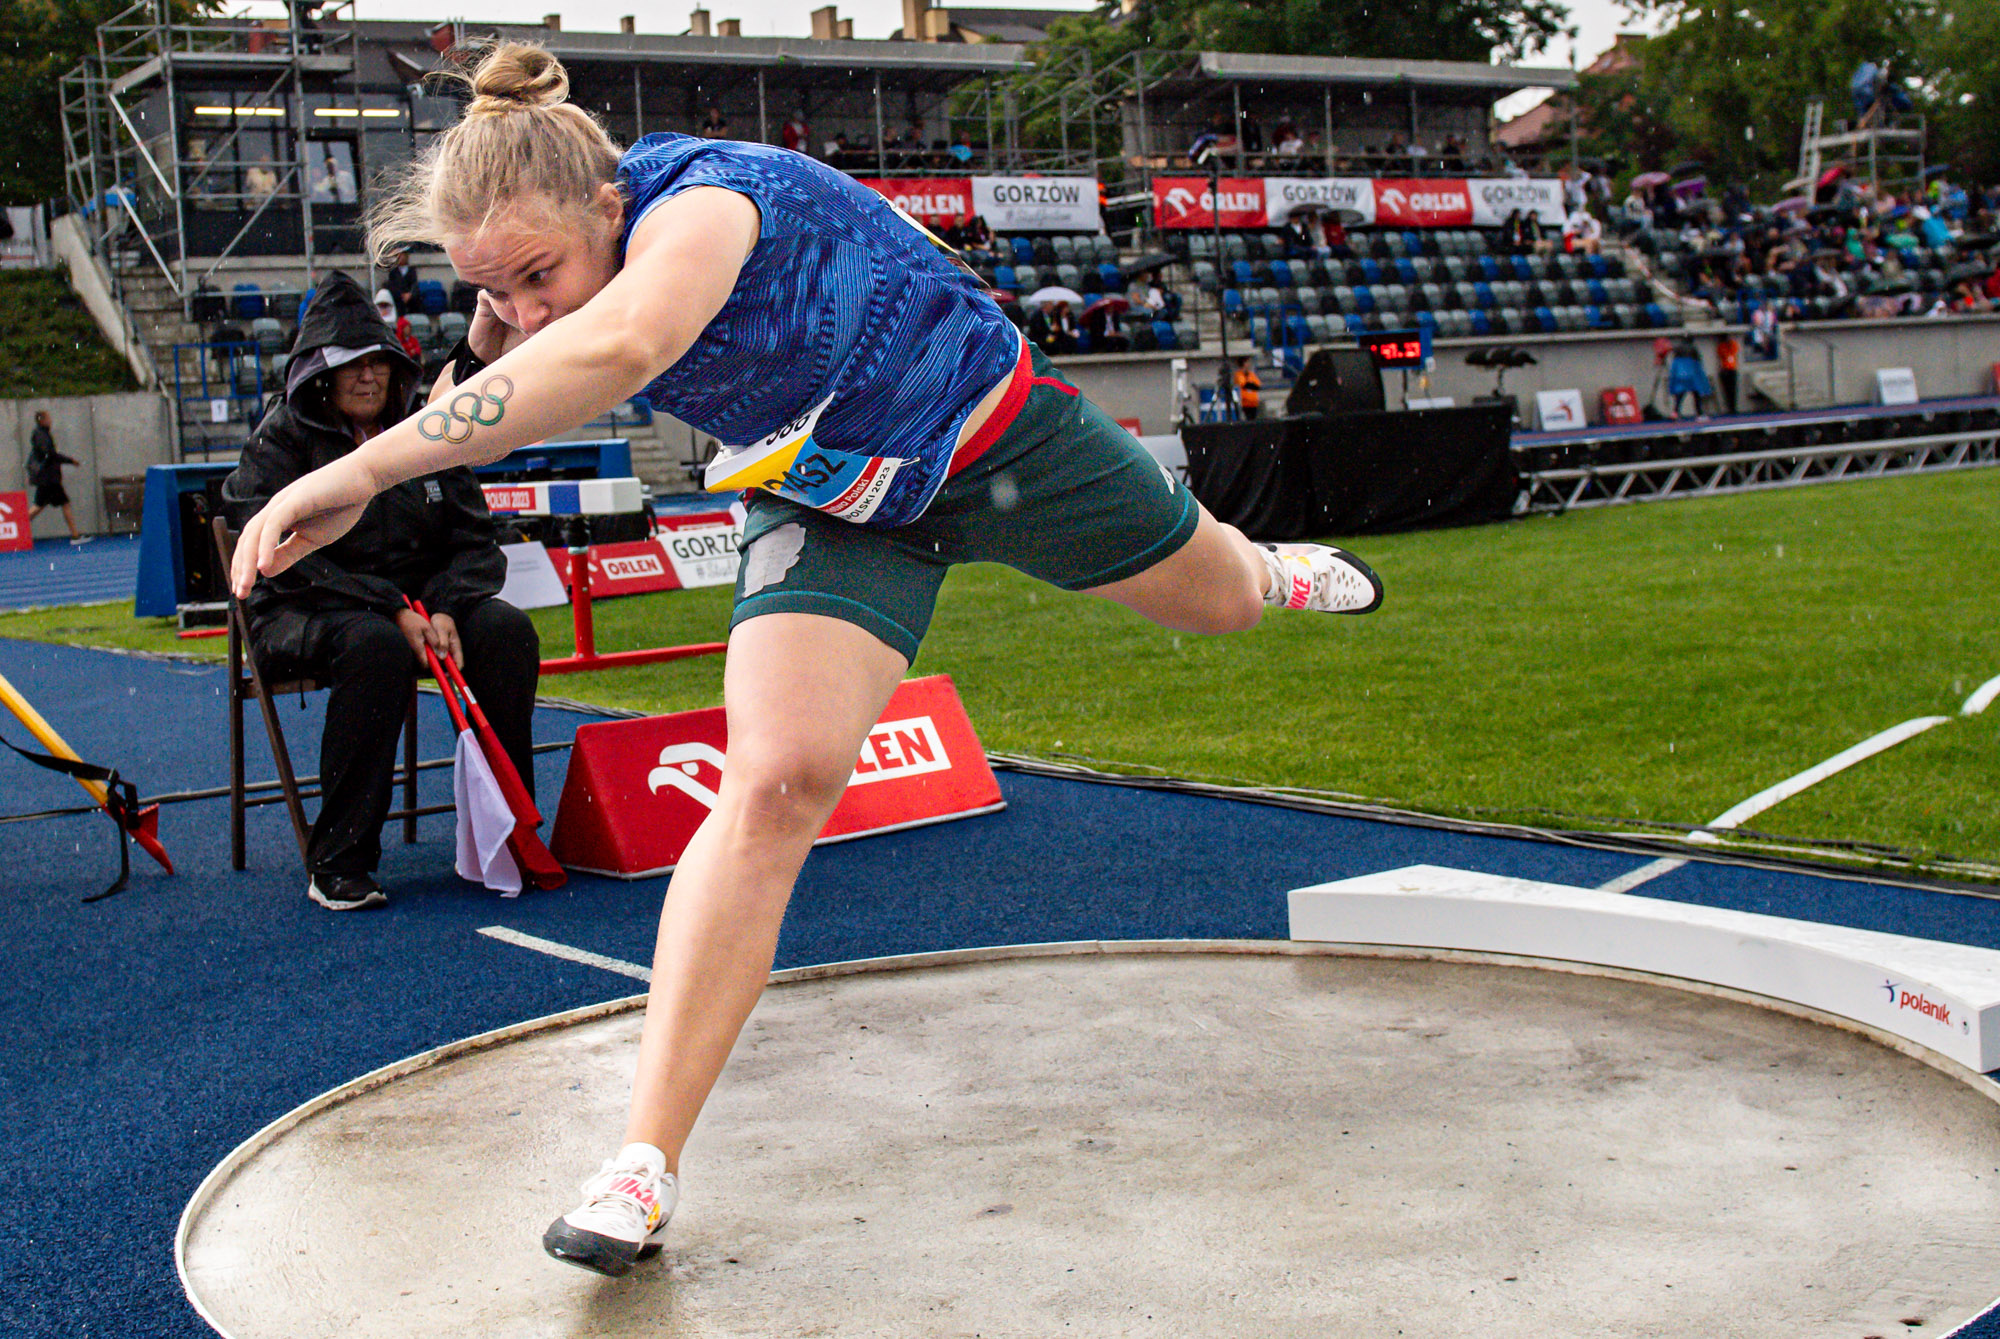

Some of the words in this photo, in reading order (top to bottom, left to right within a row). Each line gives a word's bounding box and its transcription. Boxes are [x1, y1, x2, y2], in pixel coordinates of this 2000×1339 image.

[993, 182, 1080, 203] GORZÓW
[1200, 192, 1259, 211] ORLEN
[1409, 192, 1467, 211] ORLEN
[894, 194, 965, 215] ORLEN
[871, 466, 890, 493] 2023
[511, 490, 530, 508] 2023
[844, 478, 870, 503] Polski
[607, 559, 658, 575] ORLEN
[1900, 991, 1951, 1025] polanik
